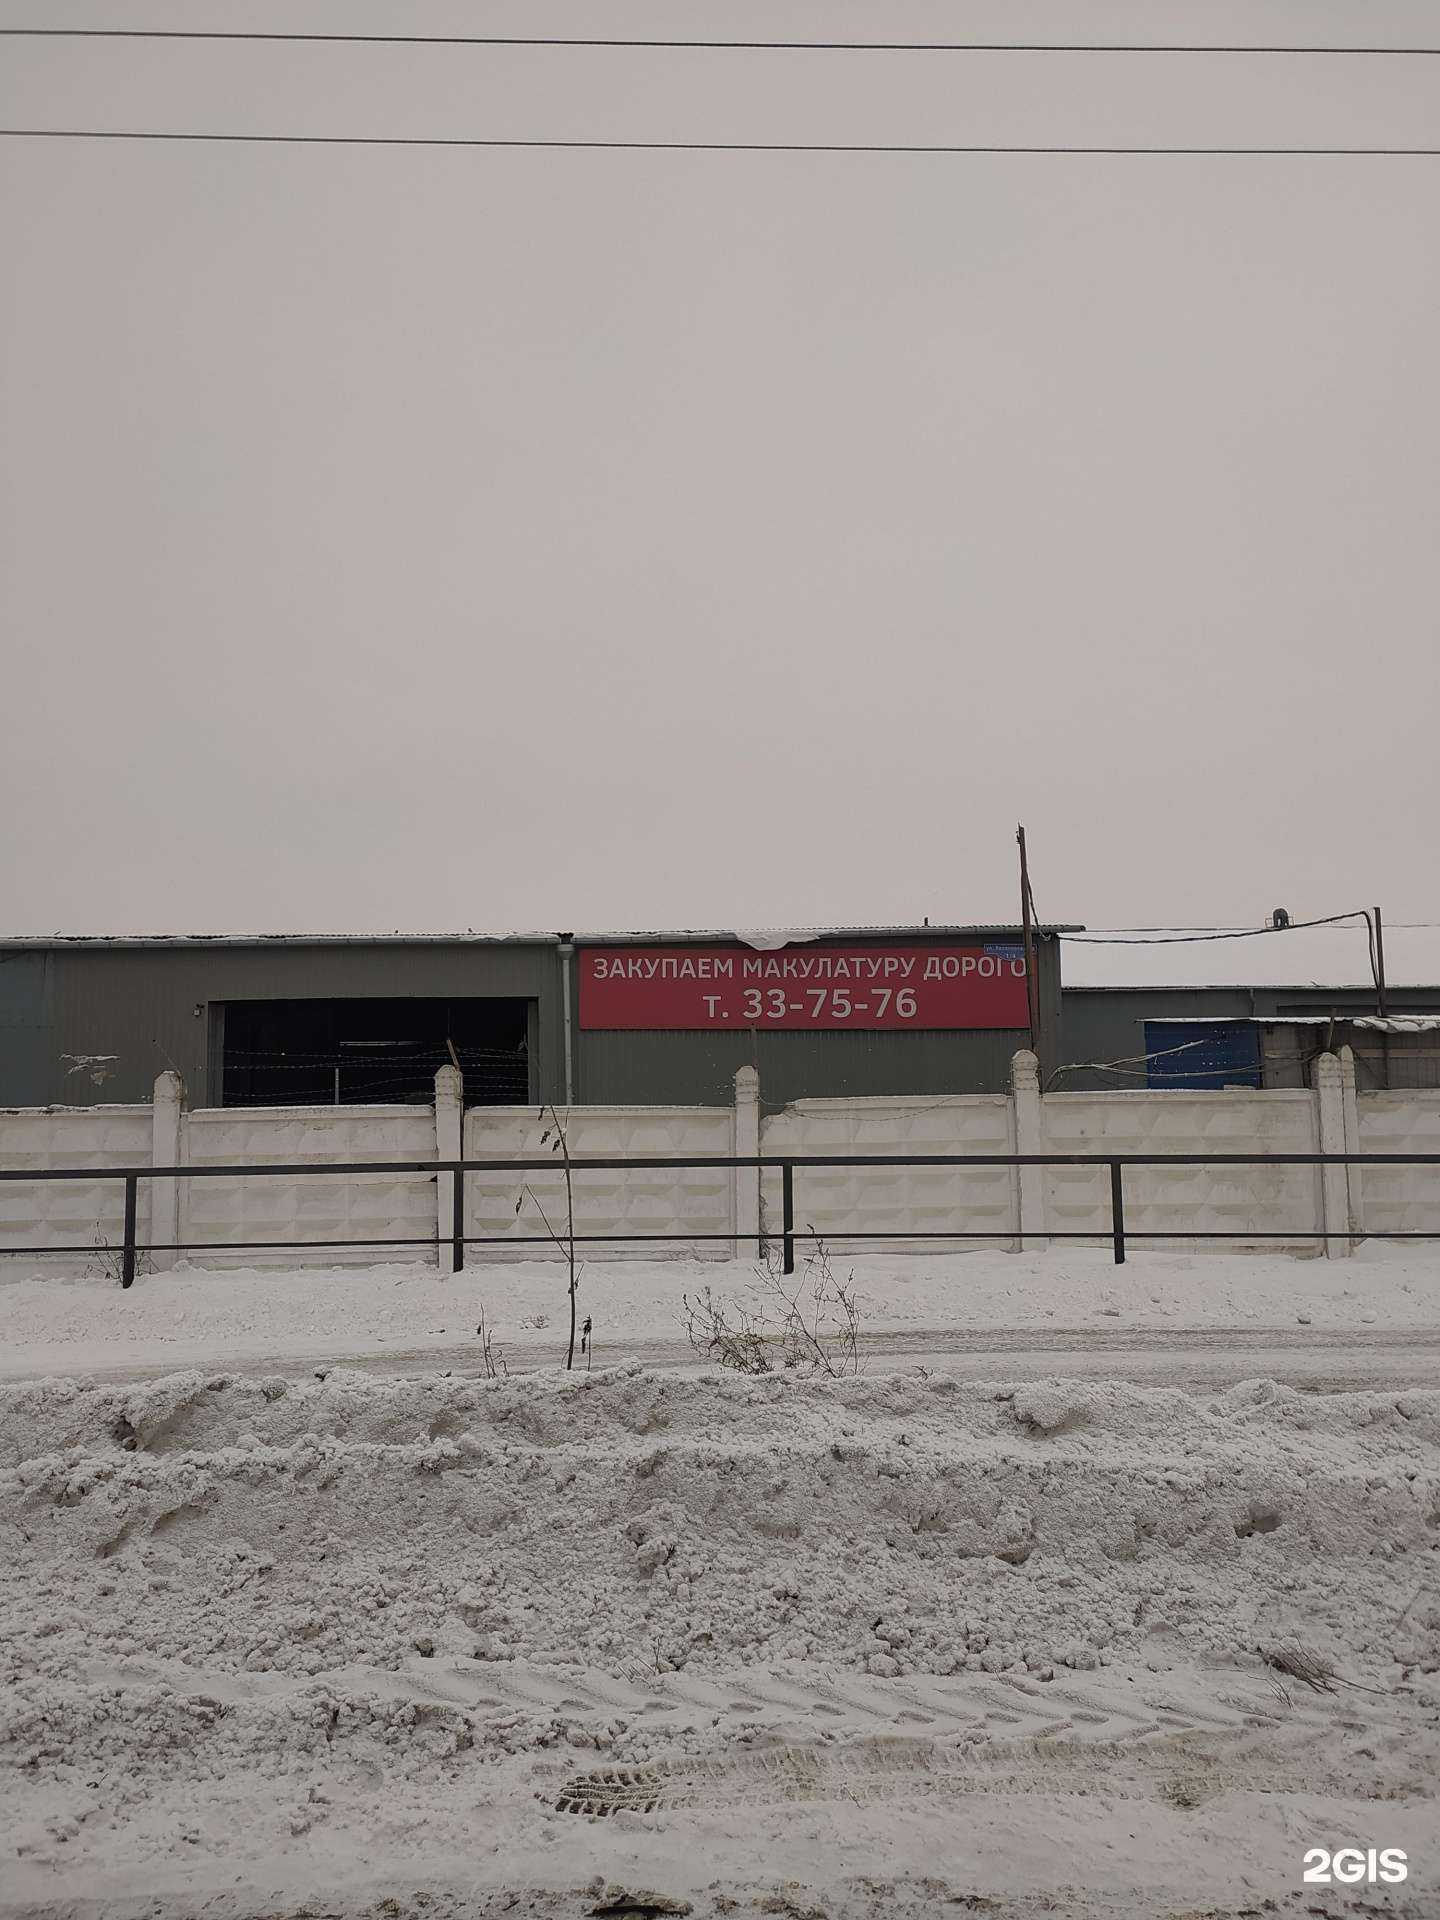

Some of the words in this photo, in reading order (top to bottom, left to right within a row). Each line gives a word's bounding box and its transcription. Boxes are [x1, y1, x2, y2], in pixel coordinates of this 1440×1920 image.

[593, 958, 733, 979] ЗАКУПАЕМ
[743, 957, 916, 979] МАКУЛАТУРУ
[743, 988, 917, 1018] 33-75-76
